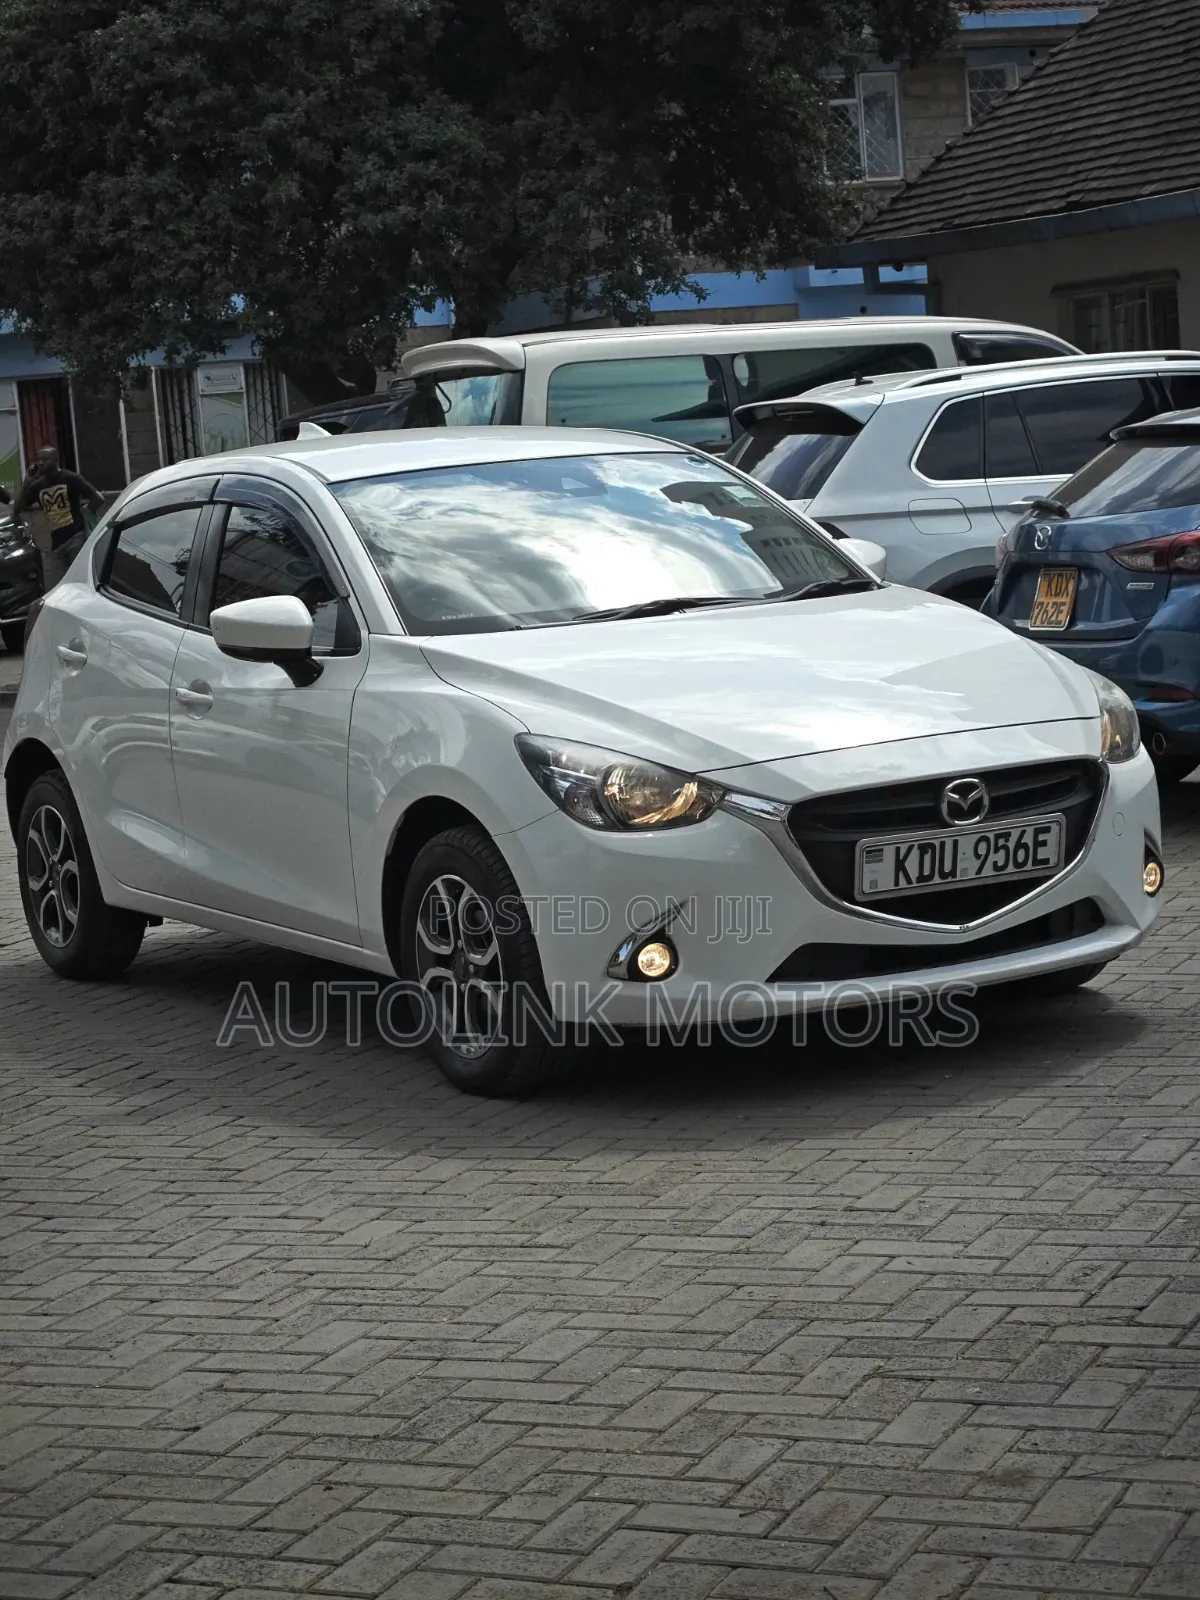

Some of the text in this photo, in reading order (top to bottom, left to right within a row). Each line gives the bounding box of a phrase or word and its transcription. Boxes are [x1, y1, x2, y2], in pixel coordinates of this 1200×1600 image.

[1045, 571, 1074, 598] KDX
[1032, 601, 1067, 626] 762E
[893, 825, 1052, 888] KDU 956E
